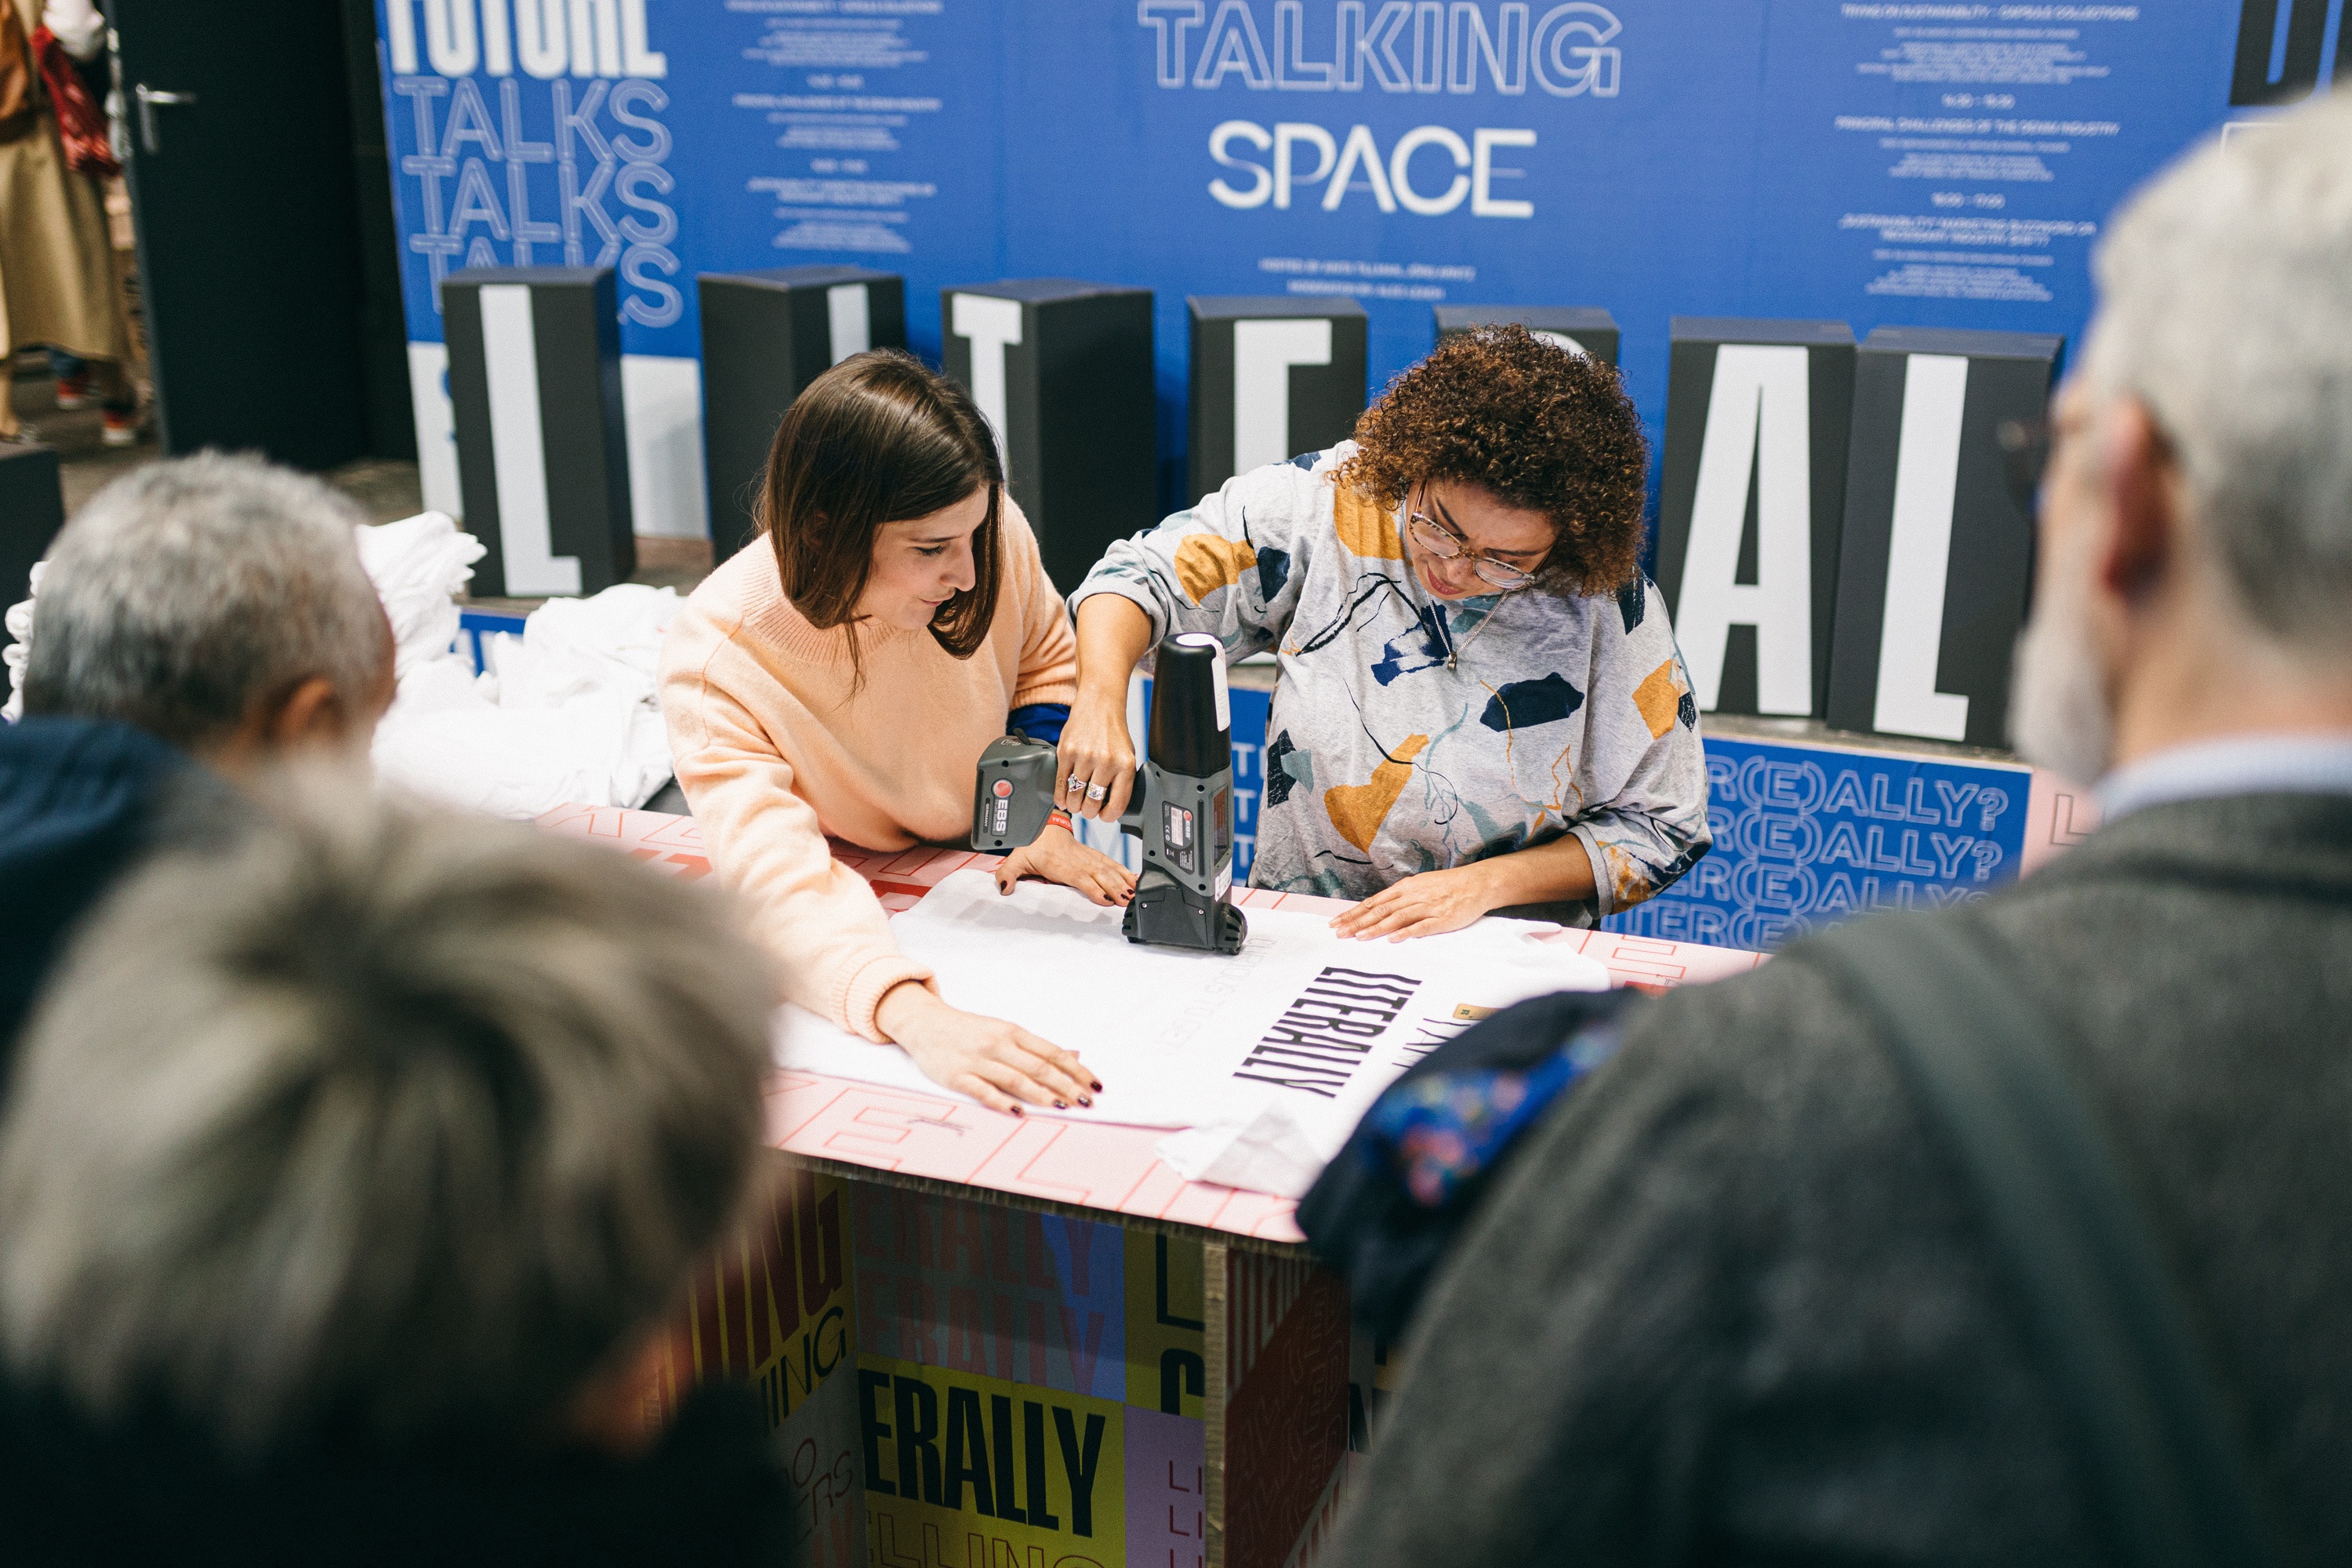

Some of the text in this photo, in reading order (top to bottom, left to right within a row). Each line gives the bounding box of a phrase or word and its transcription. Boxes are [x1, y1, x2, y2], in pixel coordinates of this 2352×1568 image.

[1138, 0, 1623, 97] TALKING
[393, 76, 672, 165] TALKS
[402, 157, 678, 245] TALKS
[1208, 120, 1537, 218] SPACE
[996, 800, 1008, 831] EBS
[1232, 966, 1423, 1098] LITERALLY
